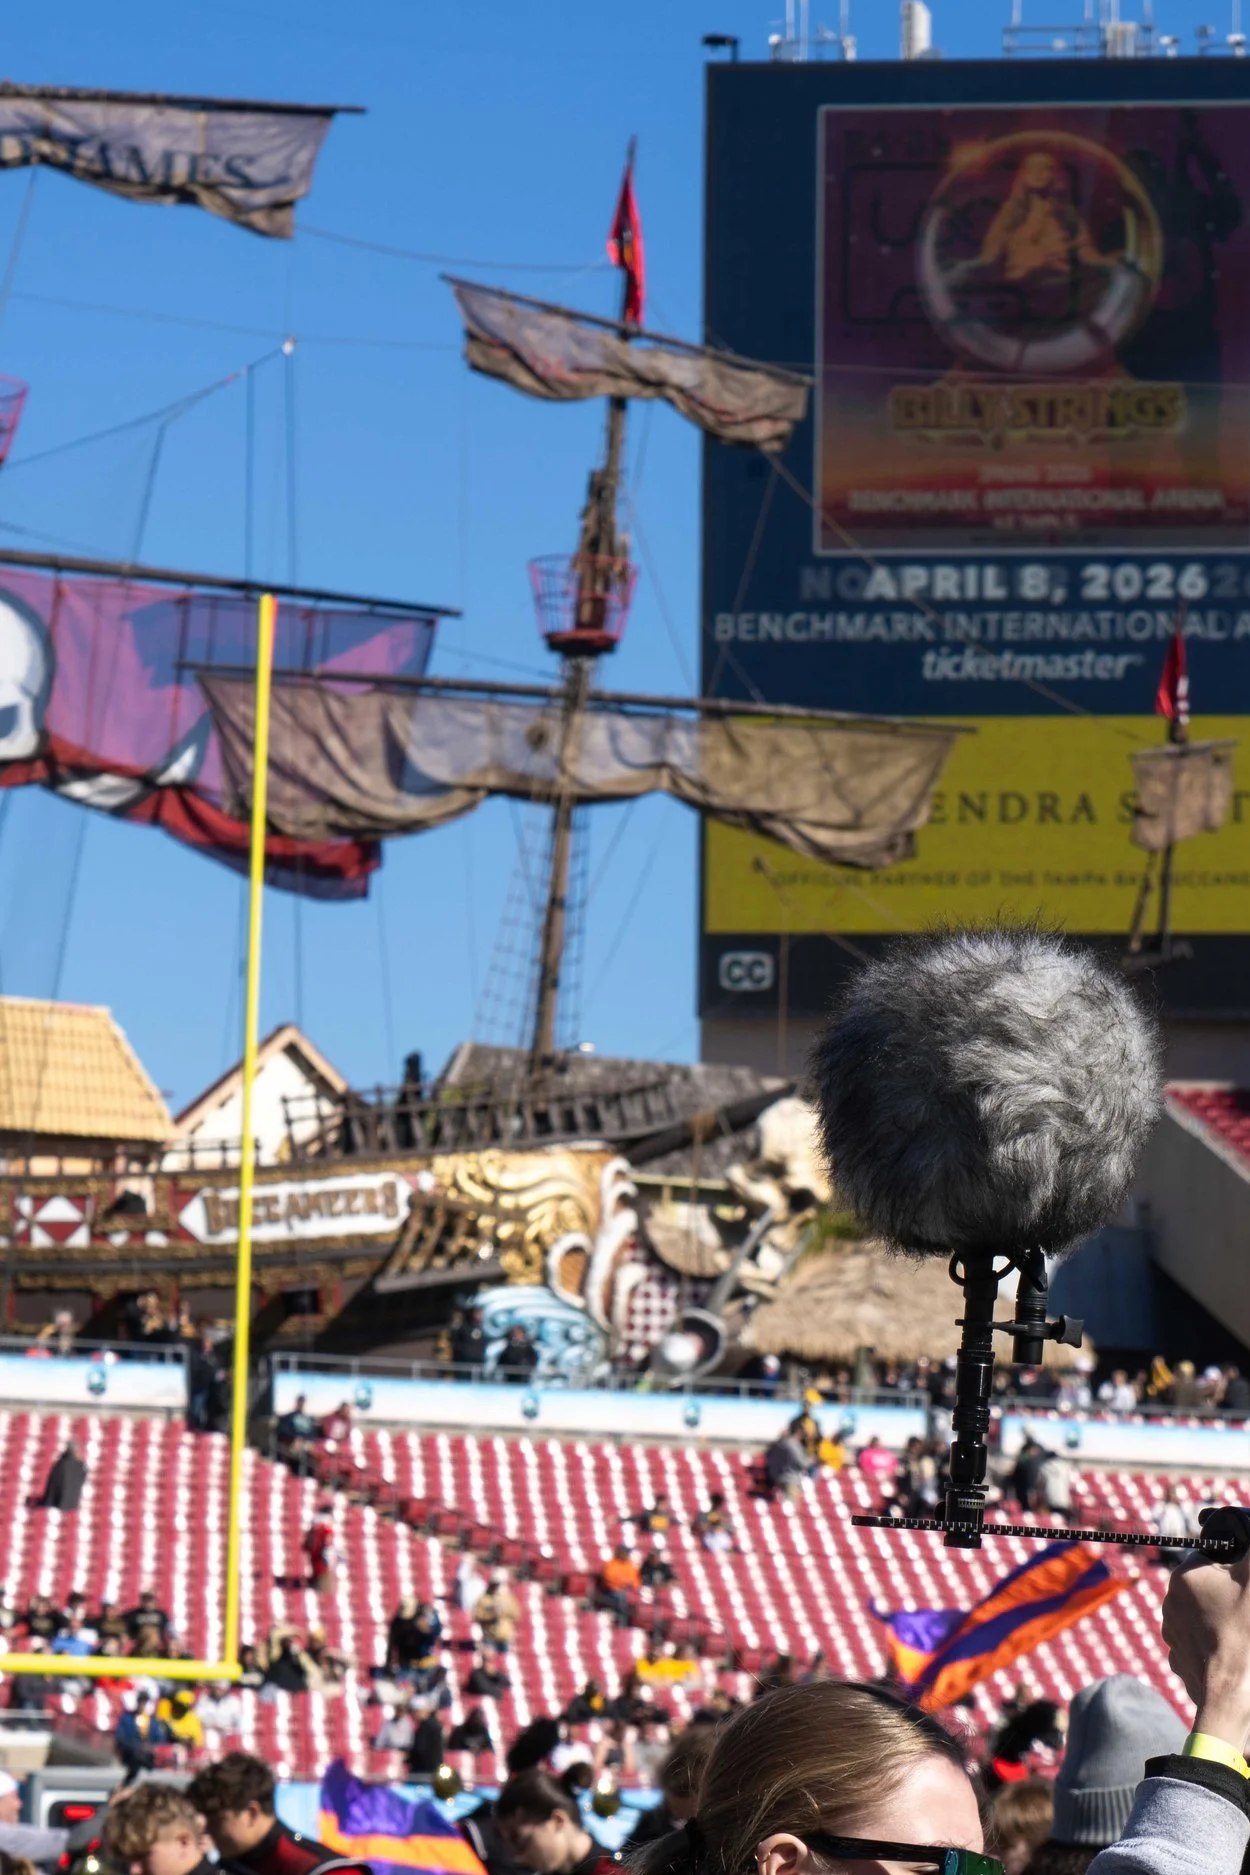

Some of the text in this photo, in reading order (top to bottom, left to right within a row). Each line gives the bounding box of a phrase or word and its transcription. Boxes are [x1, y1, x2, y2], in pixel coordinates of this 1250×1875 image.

[864, 566, 1008, 600] APRIL
[1018, 566, 1068, 605] 8,
[1080, 565, 1209, 601] 2026
[714, 612, 936, 642] BENCHMARK
[944, 611, 1227, 642] INTERNATIONAL
[922, 648, 1136, 681] ticketmaster
[927, 790, 1099, 825] ENDRA
[725, 957, 768, 987] CC
